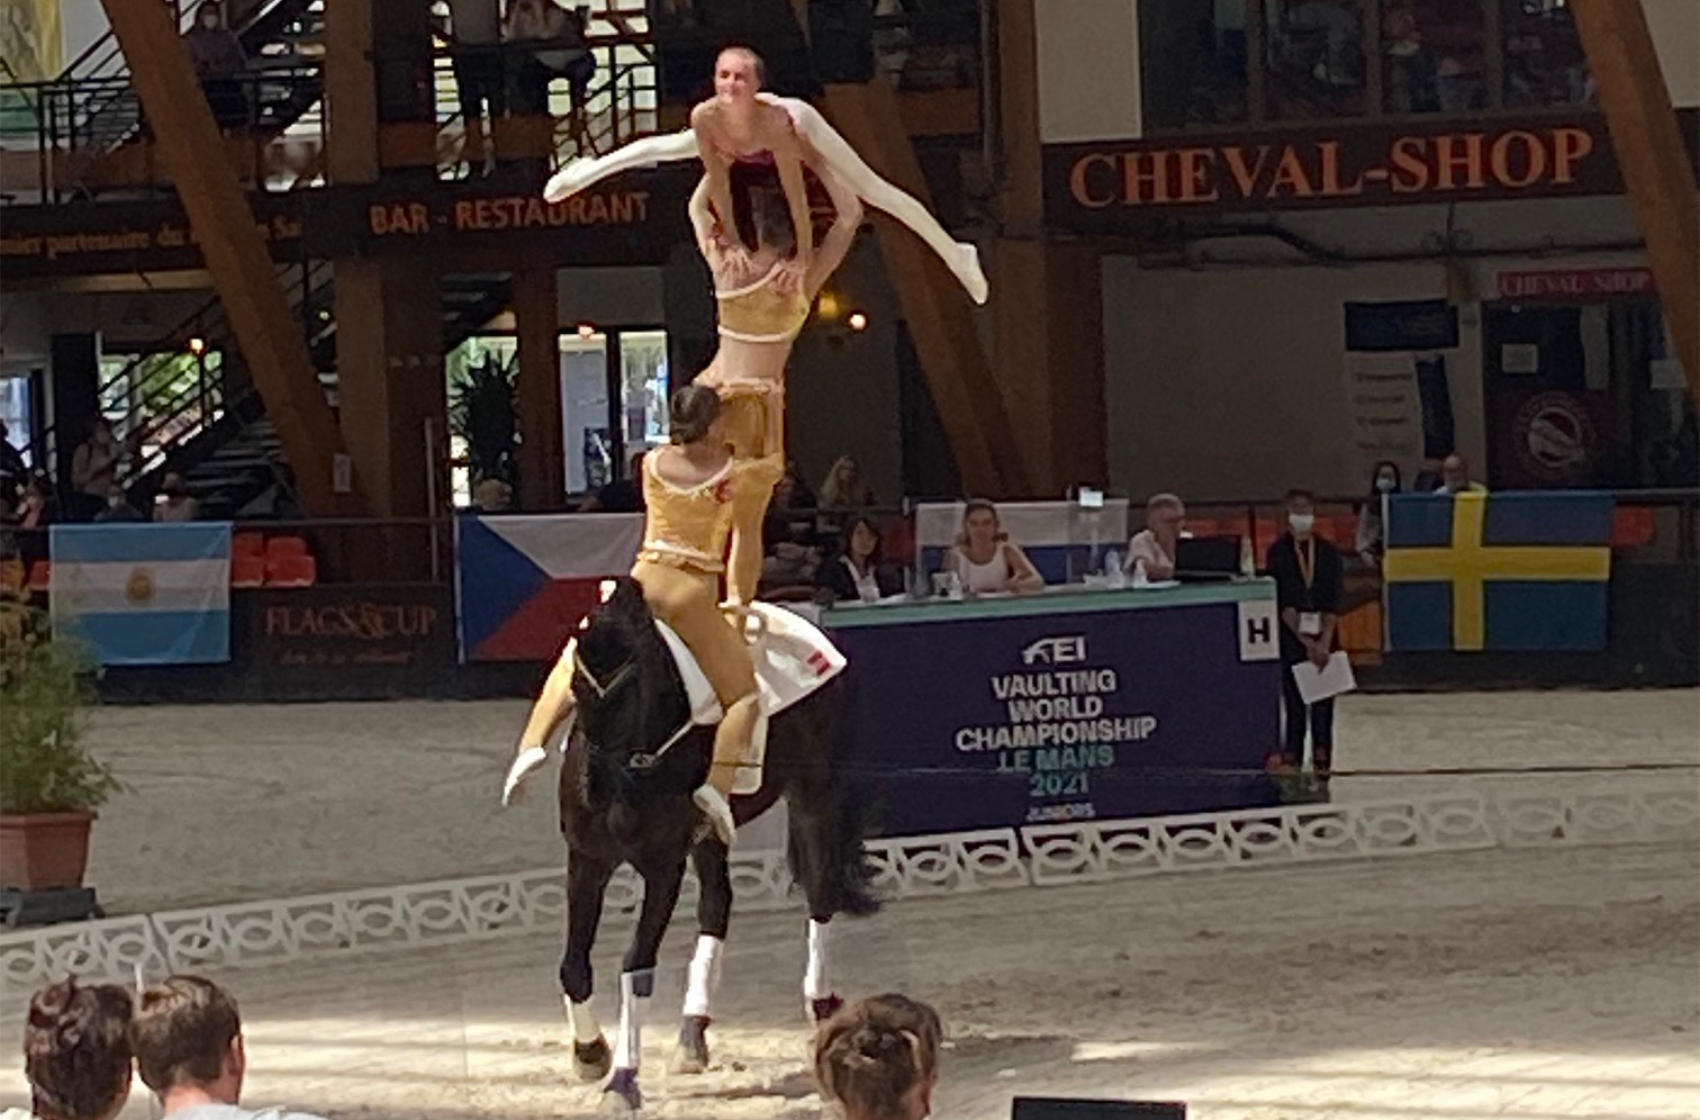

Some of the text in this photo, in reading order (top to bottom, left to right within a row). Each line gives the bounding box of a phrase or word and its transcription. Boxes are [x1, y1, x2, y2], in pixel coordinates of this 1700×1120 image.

[1070, 128, 1593, 208] CHEVAL-SHOP
[370, 204, 430, 235] BAR
[455, 192, 649, 230] RESTAURANT
[1247, 616, 1270, 644] H
[991, 669, 1117, 700] VAULTING
[1008, 696, 1103, 724] WORLD
[956, 716, 1157, 752] CHAMPIONSHIP
[999, 745, 1115, 773] LE MANS
[1030, 771, 1089, 797] 2021
